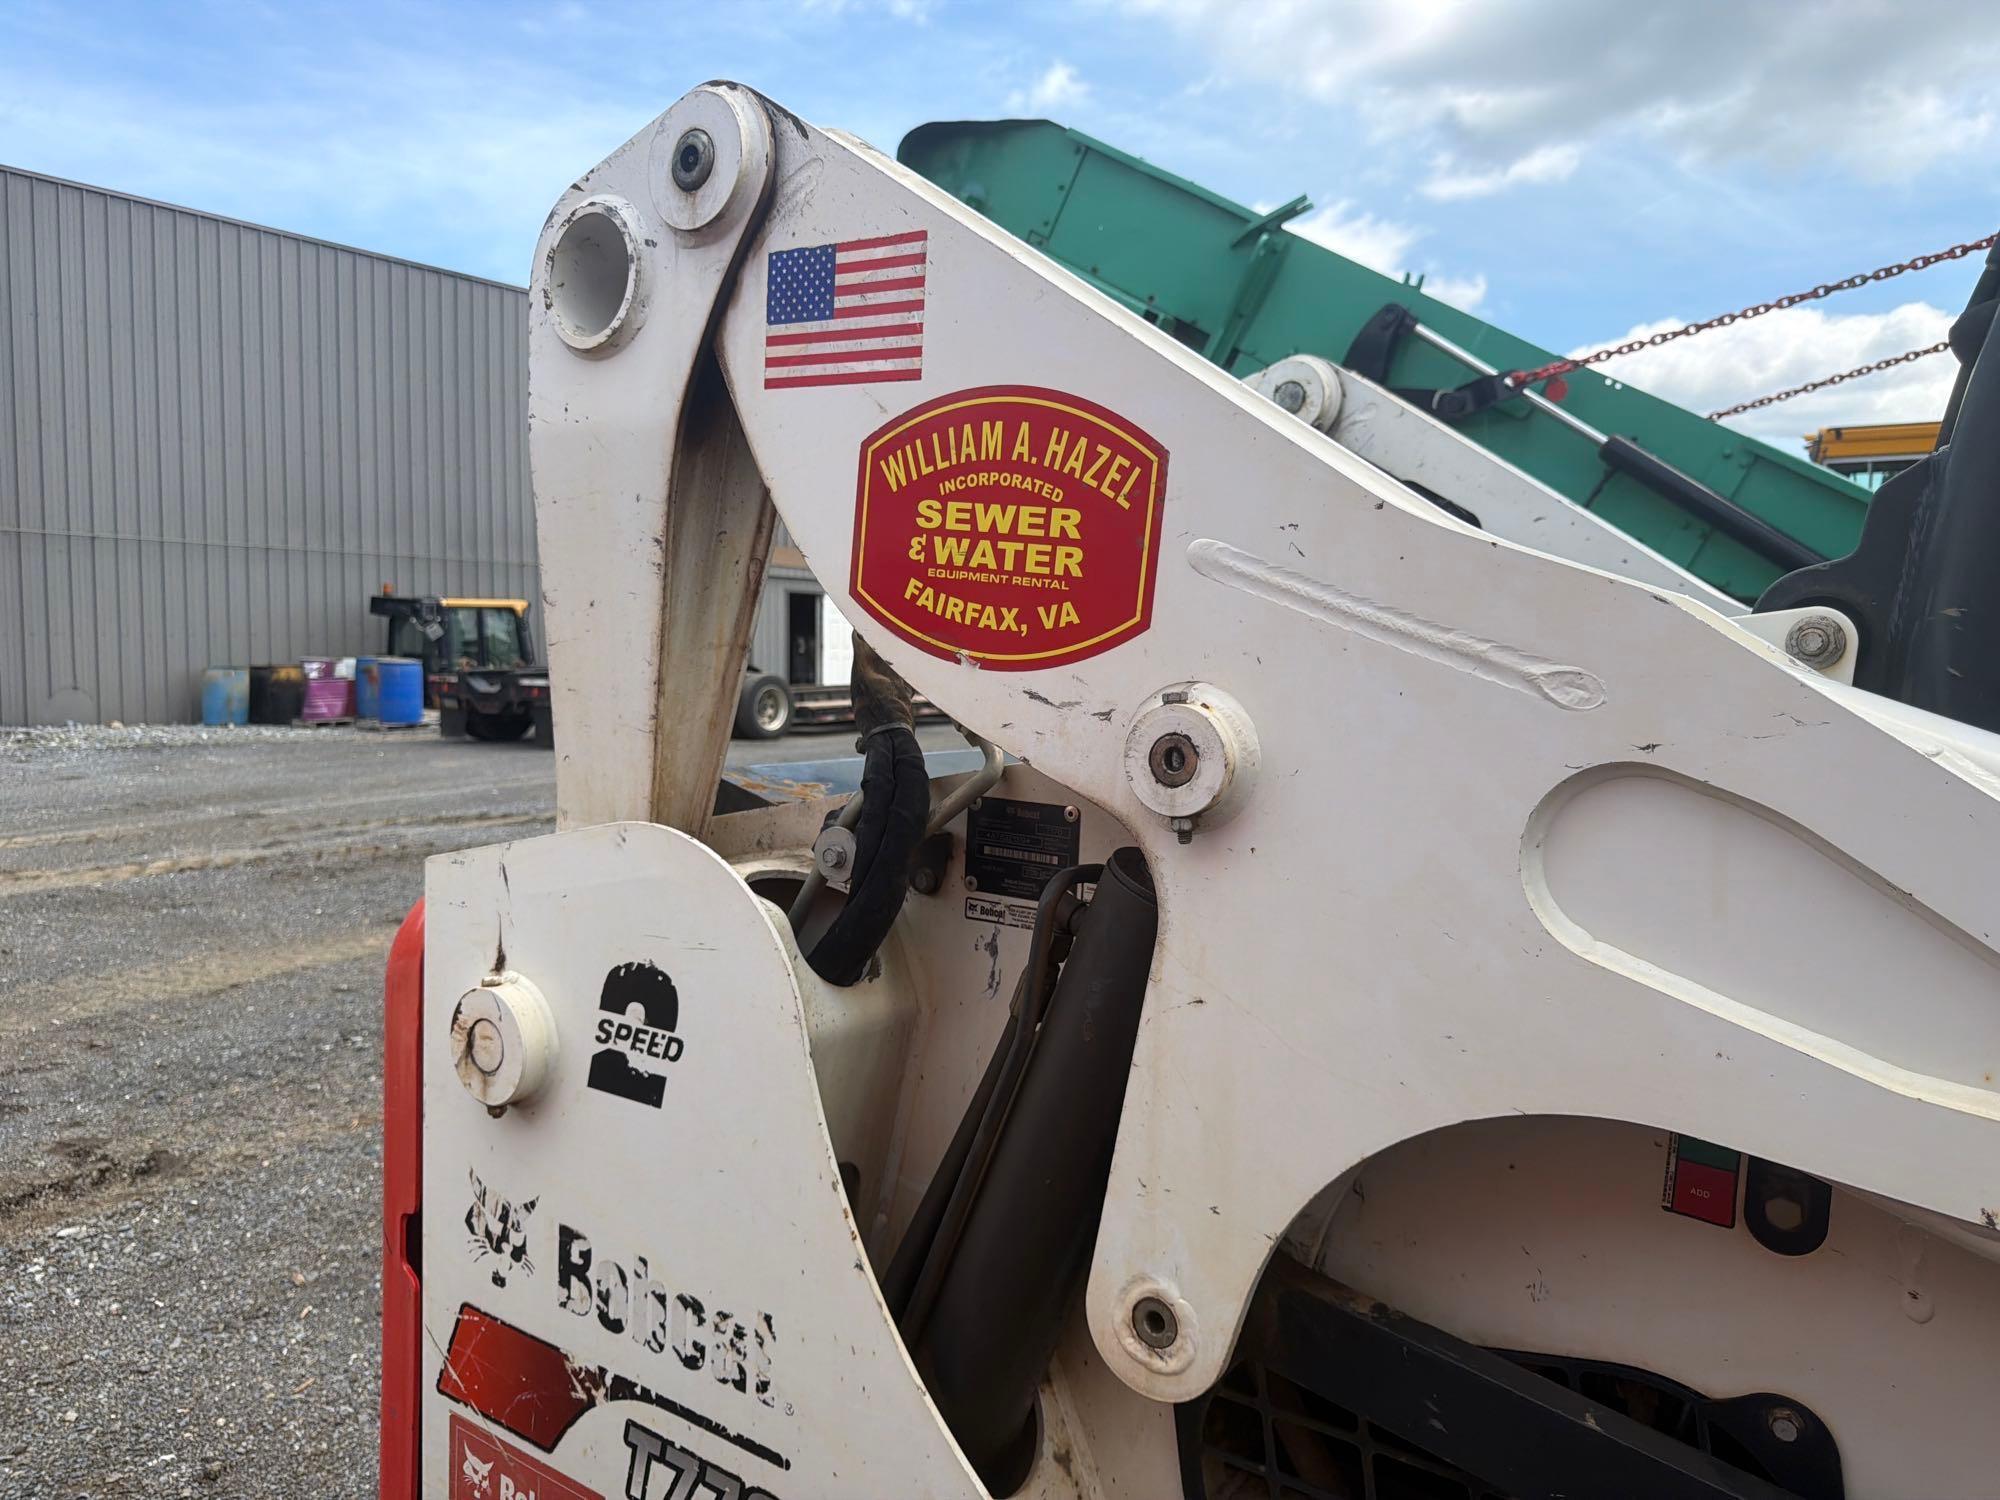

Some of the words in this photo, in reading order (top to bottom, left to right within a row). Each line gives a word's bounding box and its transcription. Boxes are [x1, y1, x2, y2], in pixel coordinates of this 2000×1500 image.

[880, 421, 1003, 493] WILLIAM
[1011, 421, 1037, 464] A.
[1043, 427, 1142, 510] HAZEL
[939, 472, 1064, 503] INCORPORATED
[915, 500, 1082, 539] SEWER
[908, 533, 927, 563] &
[933, 535, 1084, 577] WATER
[927, 568, 1009, 584] EQUIPMENT
[1012, 576, 1070, 590] RENTAL
[904, 577, 1028, 637] FAIRFAX,
[1037, 601, 1081, 630] VA
[595, 1018, 684, 1062] SPEED
[1690, 1187, 1710, 1198] ADD
[623, 1418, 782, 1500] T77
